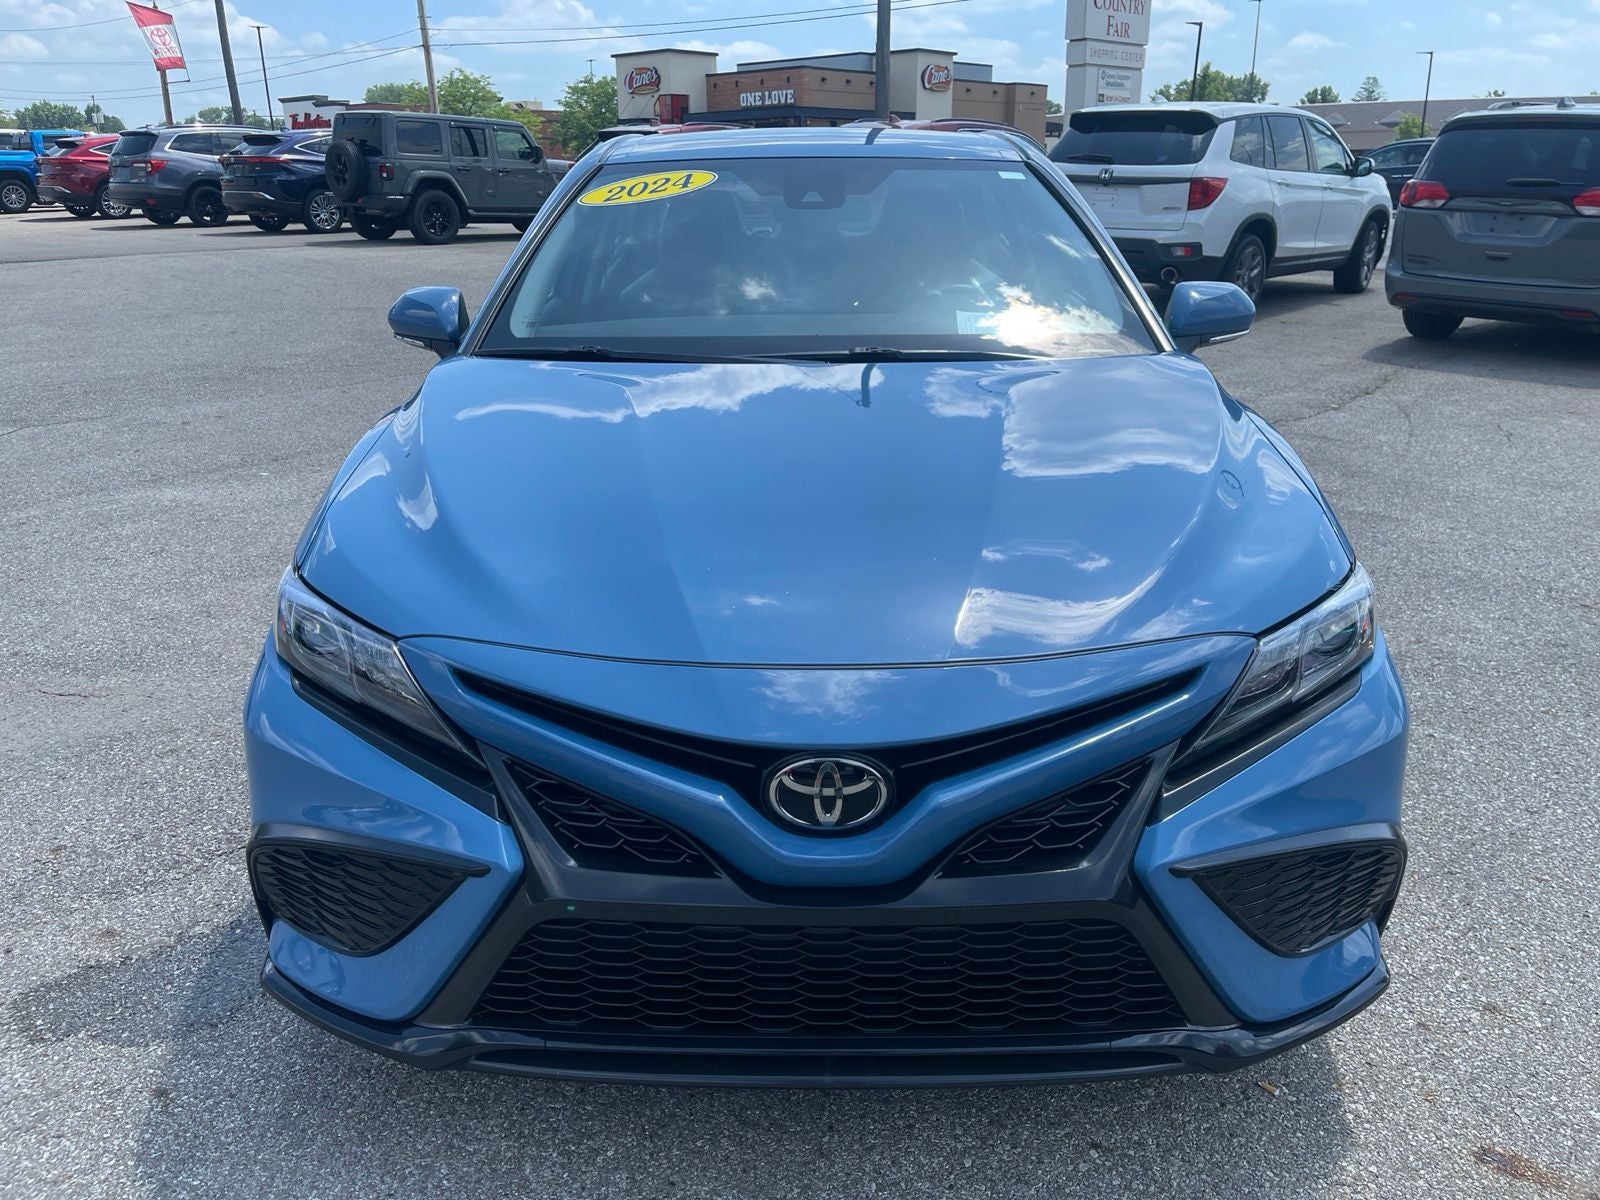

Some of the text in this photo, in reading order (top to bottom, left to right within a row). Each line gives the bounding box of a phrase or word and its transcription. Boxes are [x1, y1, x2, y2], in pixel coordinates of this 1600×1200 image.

[1106, 15, 1130, 39] FAIR
[1121, 50, 1143, 62] CENTER
[625, 67, 657, 92] Cane's
[740, 89, 795, 107] ONE LOVE
[603, 173, 694, 203] 2024
